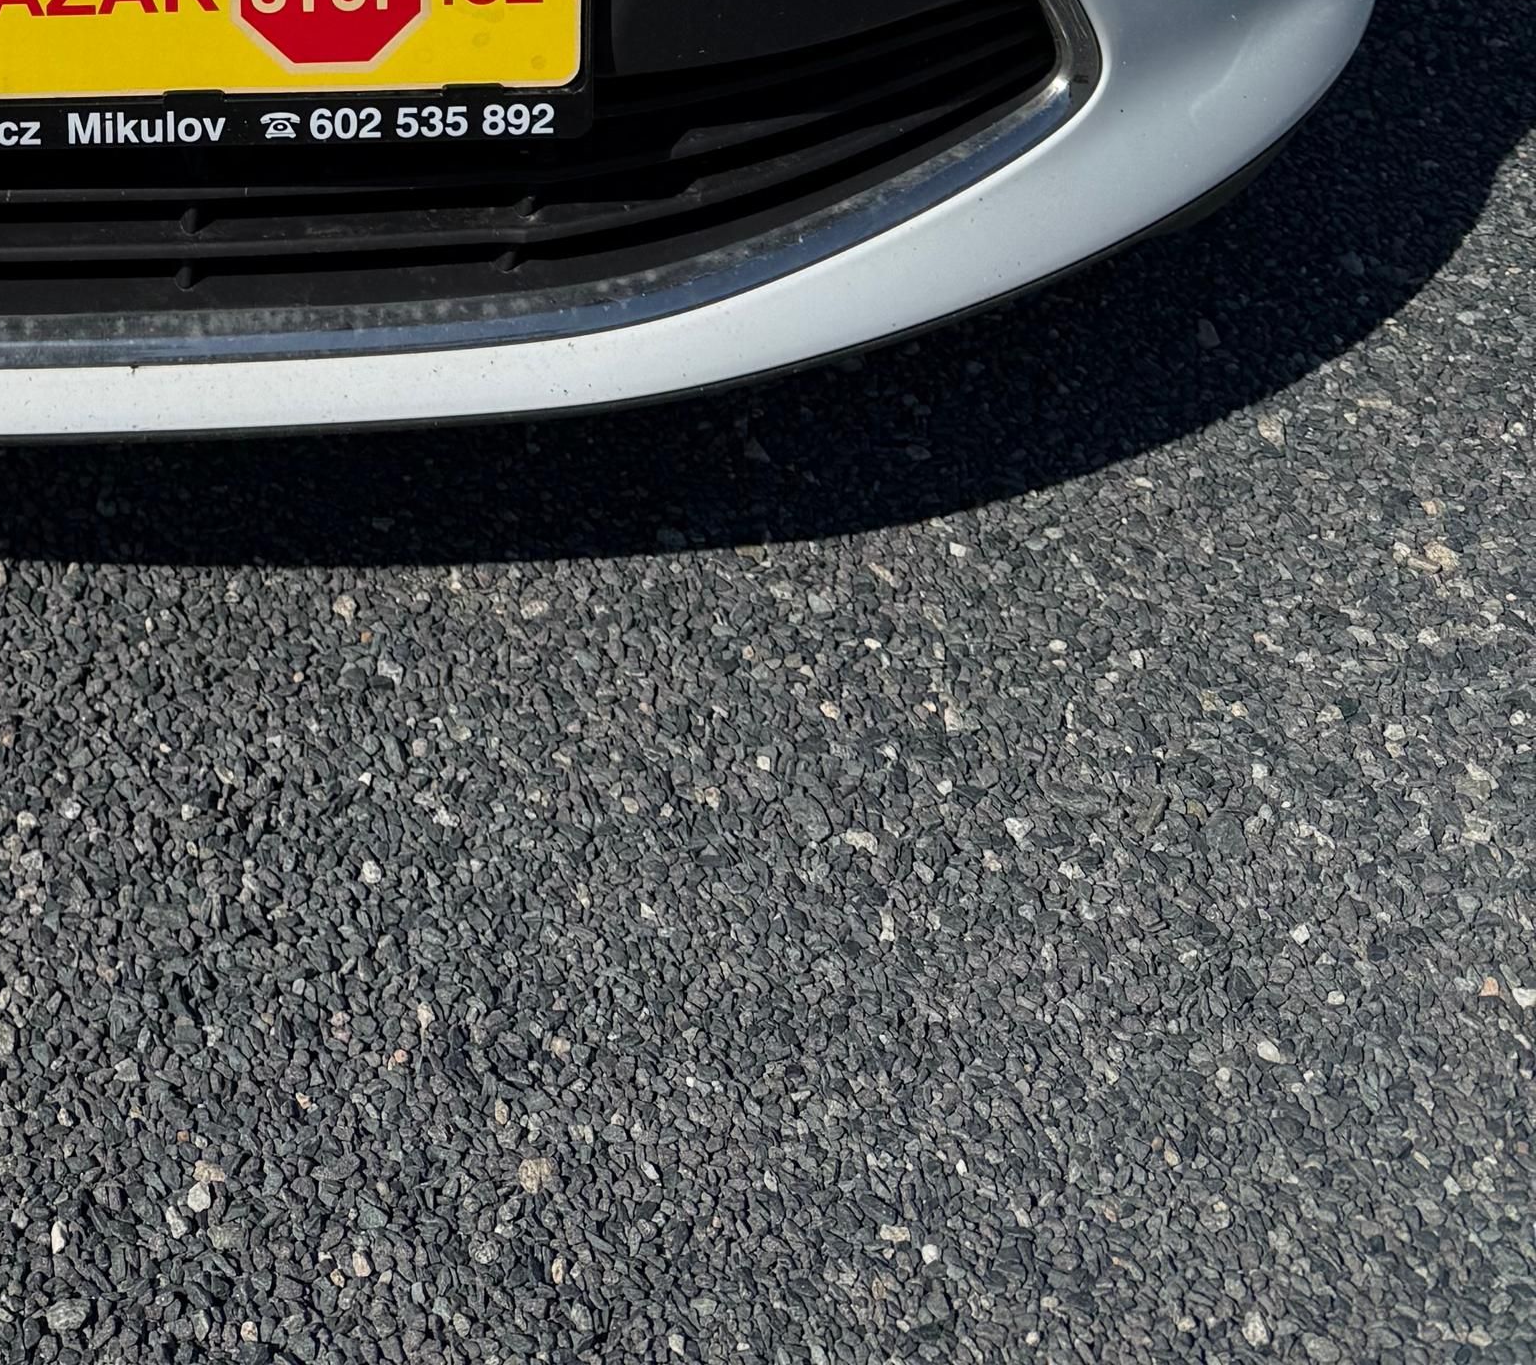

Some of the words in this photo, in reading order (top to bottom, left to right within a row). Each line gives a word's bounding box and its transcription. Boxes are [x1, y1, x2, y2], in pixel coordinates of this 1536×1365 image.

[67, 110, 226, 145] Mikulov
[309, 107, 382, 140] 602
[395, 106, 468, 138] 535
[482, 103, 555, 136] 892
